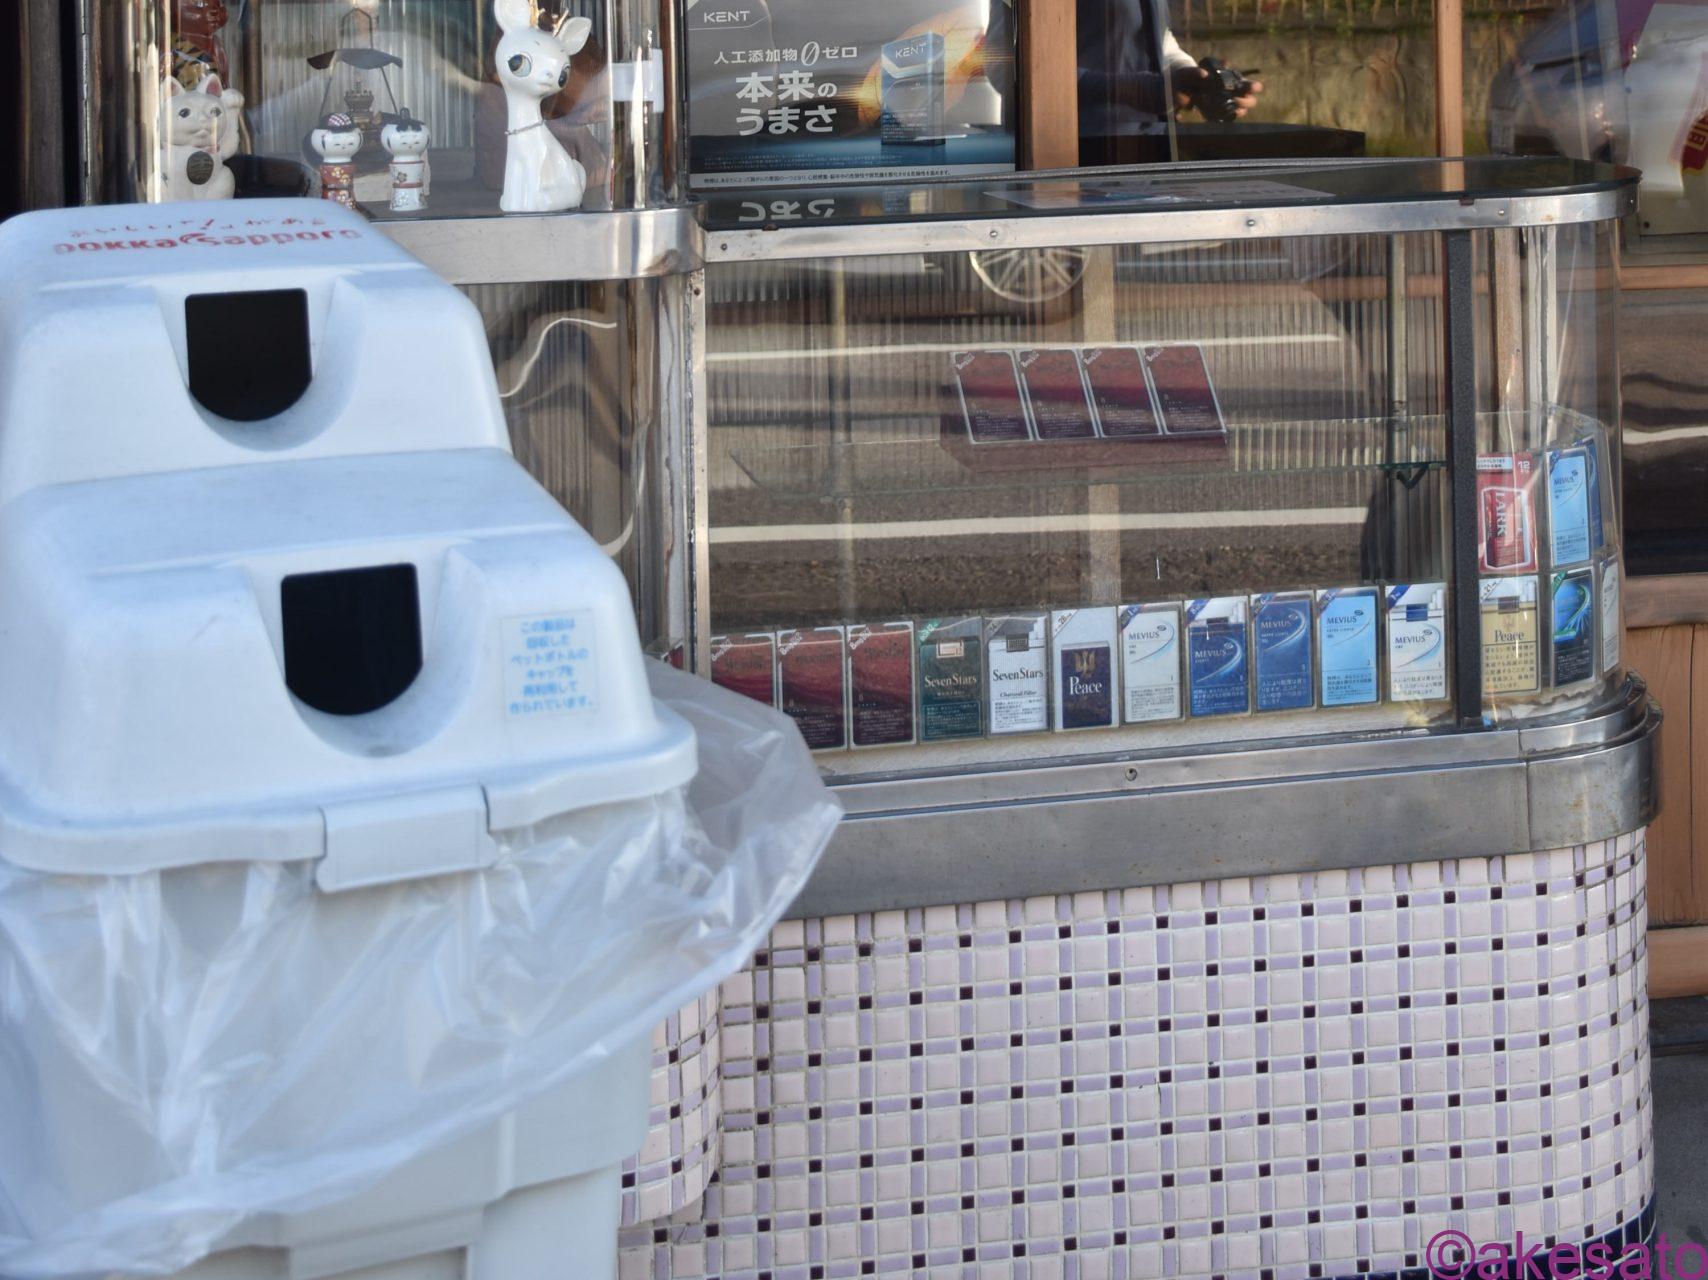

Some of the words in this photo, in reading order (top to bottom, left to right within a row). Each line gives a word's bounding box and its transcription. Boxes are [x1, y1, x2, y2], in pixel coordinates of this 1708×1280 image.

[703, 10, 751, 23] KENT
[895, 43, 927, 60] KENT
[735, 71, 838, 104] 本来の
[735, 104, 838, 137] うまさ
[1495, 492, 1507, 538] LARK
[1261, 620, 1291, 629] MEVIUS
[1327, 616, 1357, 625] MEVIUS
[1128, 631, 1160, 641] MEVIUS
[1394, 635, 1426, 644] MEVIUS
[1494, 629, 1525, 642] Peace
[1194, 648, 1227, 658] MEVIUS
[1069, 676, 1103, 695] Peace
